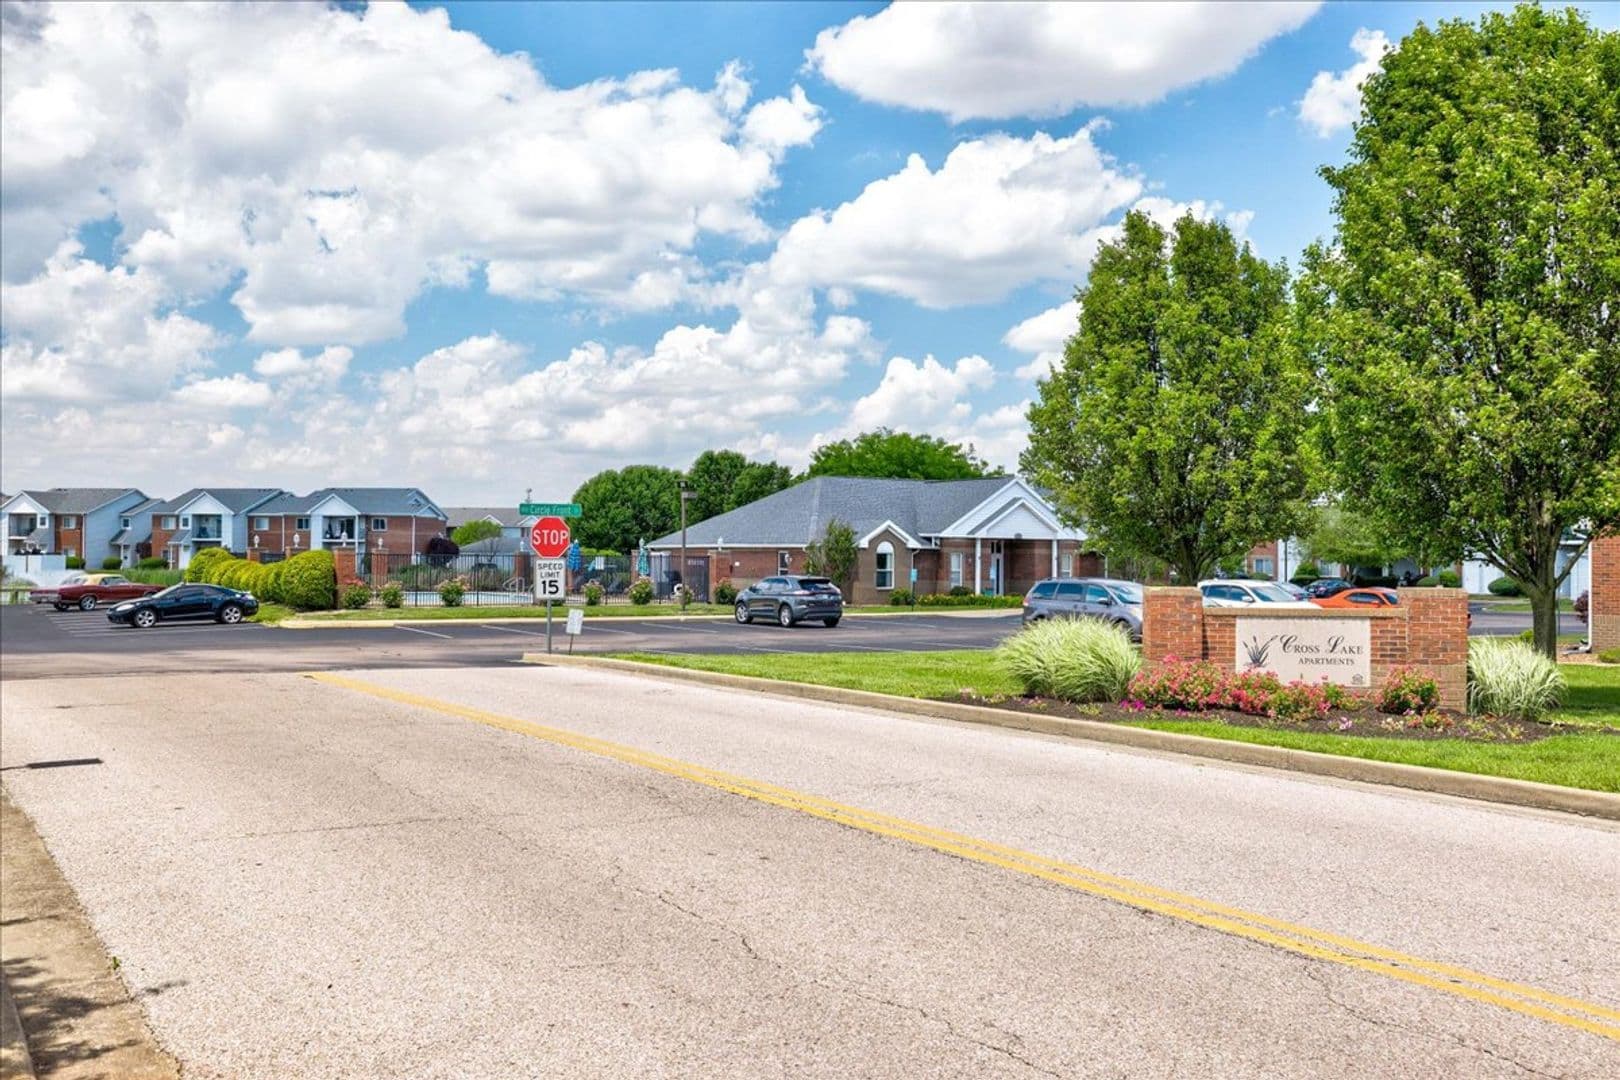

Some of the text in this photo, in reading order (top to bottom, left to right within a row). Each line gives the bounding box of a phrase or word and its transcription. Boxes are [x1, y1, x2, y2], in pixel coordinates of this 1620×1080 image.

[533, 529, 568, 545] STOP
[538, 562, 563, 570] SPEED
[541, 580, 559, 594] 15
[1280, 634, 1363, 655] CROSS LAKE
[1298, 657, 1355, 666] APARTMENTS
